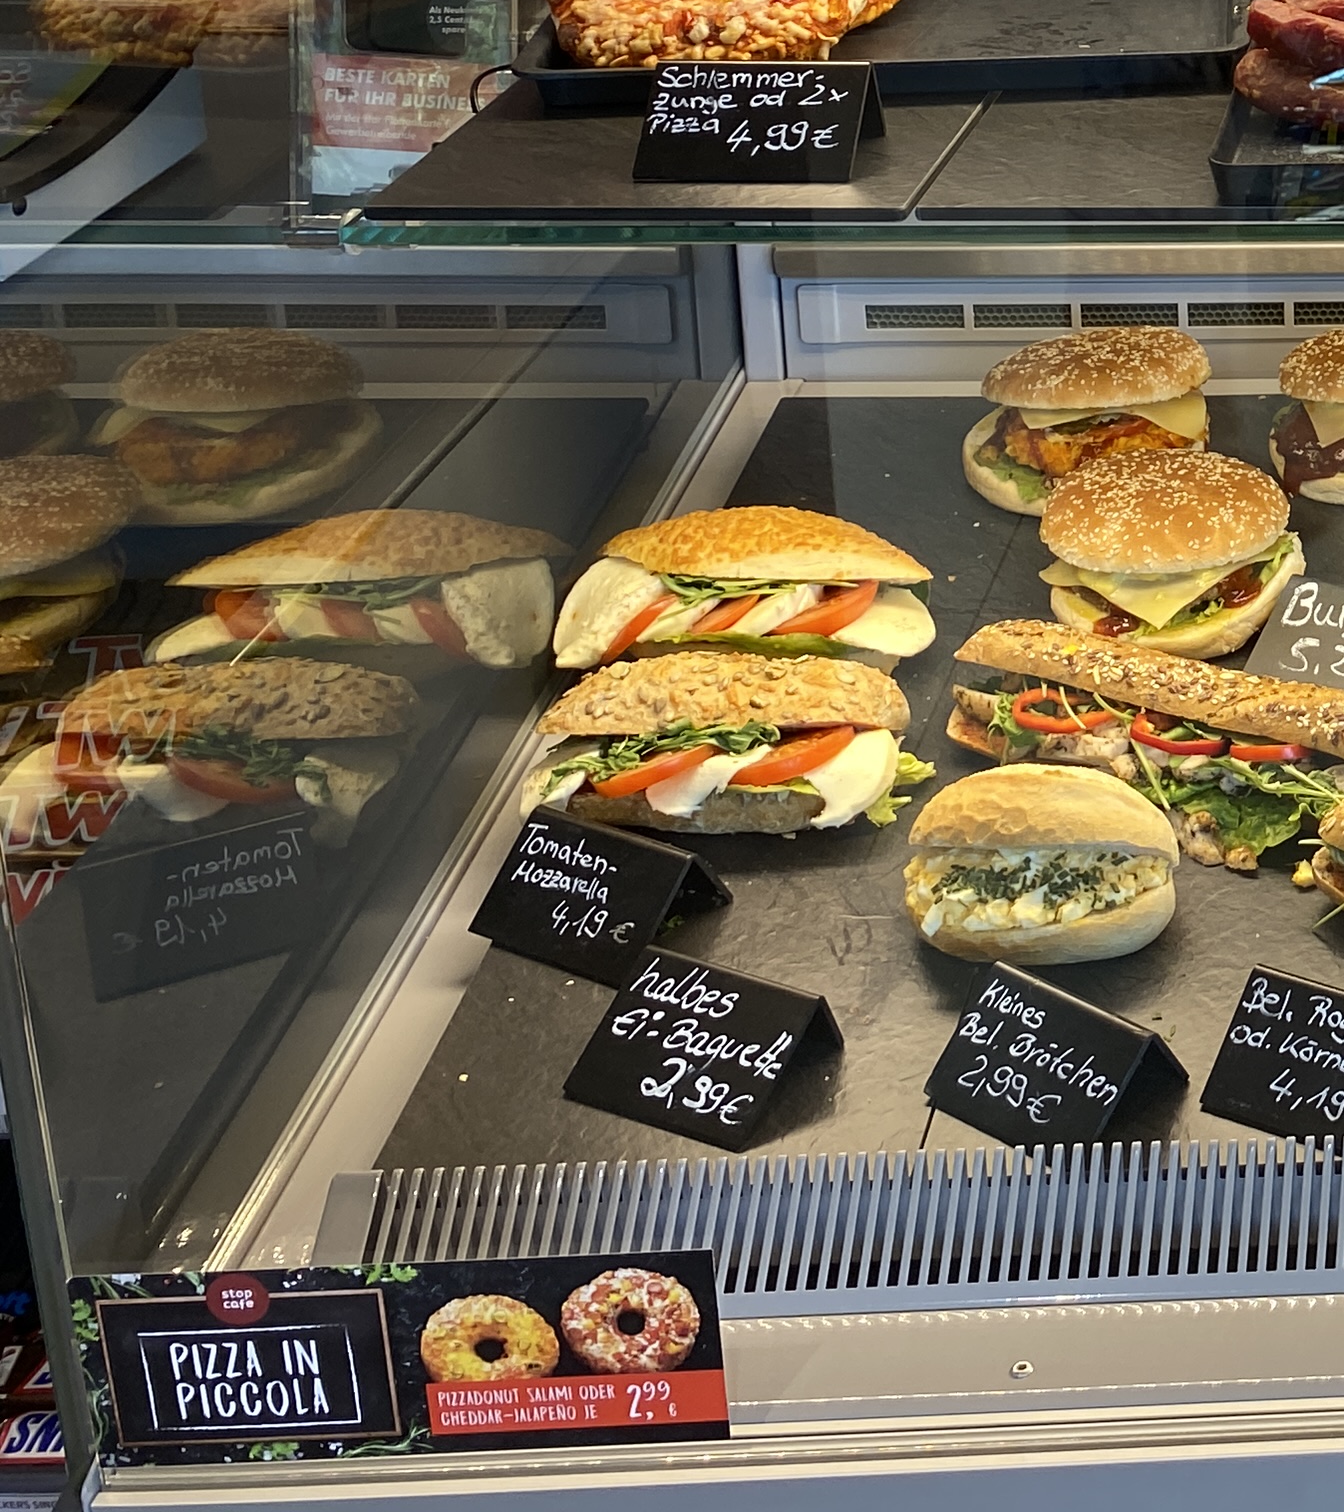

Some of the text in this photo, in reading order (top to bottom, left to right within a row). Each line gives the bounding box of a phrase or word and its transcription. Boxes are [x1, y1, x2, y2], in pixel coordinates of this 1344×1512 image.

[749, 88, 784, 107] od
[647, 114, 720, 135] Pizza
[518, 823, 617, 875] Tomaten-
[511, 862, 609, 904] Mozzarella
[630, 957, 740, 1018] halbes
[978, 978, 1046, 1029] Kleines
[1242, 977, 1293, 1022] Bel.
[1230, 1025, 1271, 1049] od.
[959, 1012, 1118, 1107] Bel. Brötchen
[222, 1289, 253, 1302] stop
[223, 1298, 255, 1310] cafe
[169, 1339, 320, 1380] PIZZA IN
[176, 1378, 330, 1420] PICCOLA
[438, 1384, 615, 1407] PIZZADONUT SALAMI ODER
[440, 1403, 597, 1427] CHEDDAR-JALAPEÑO JE
